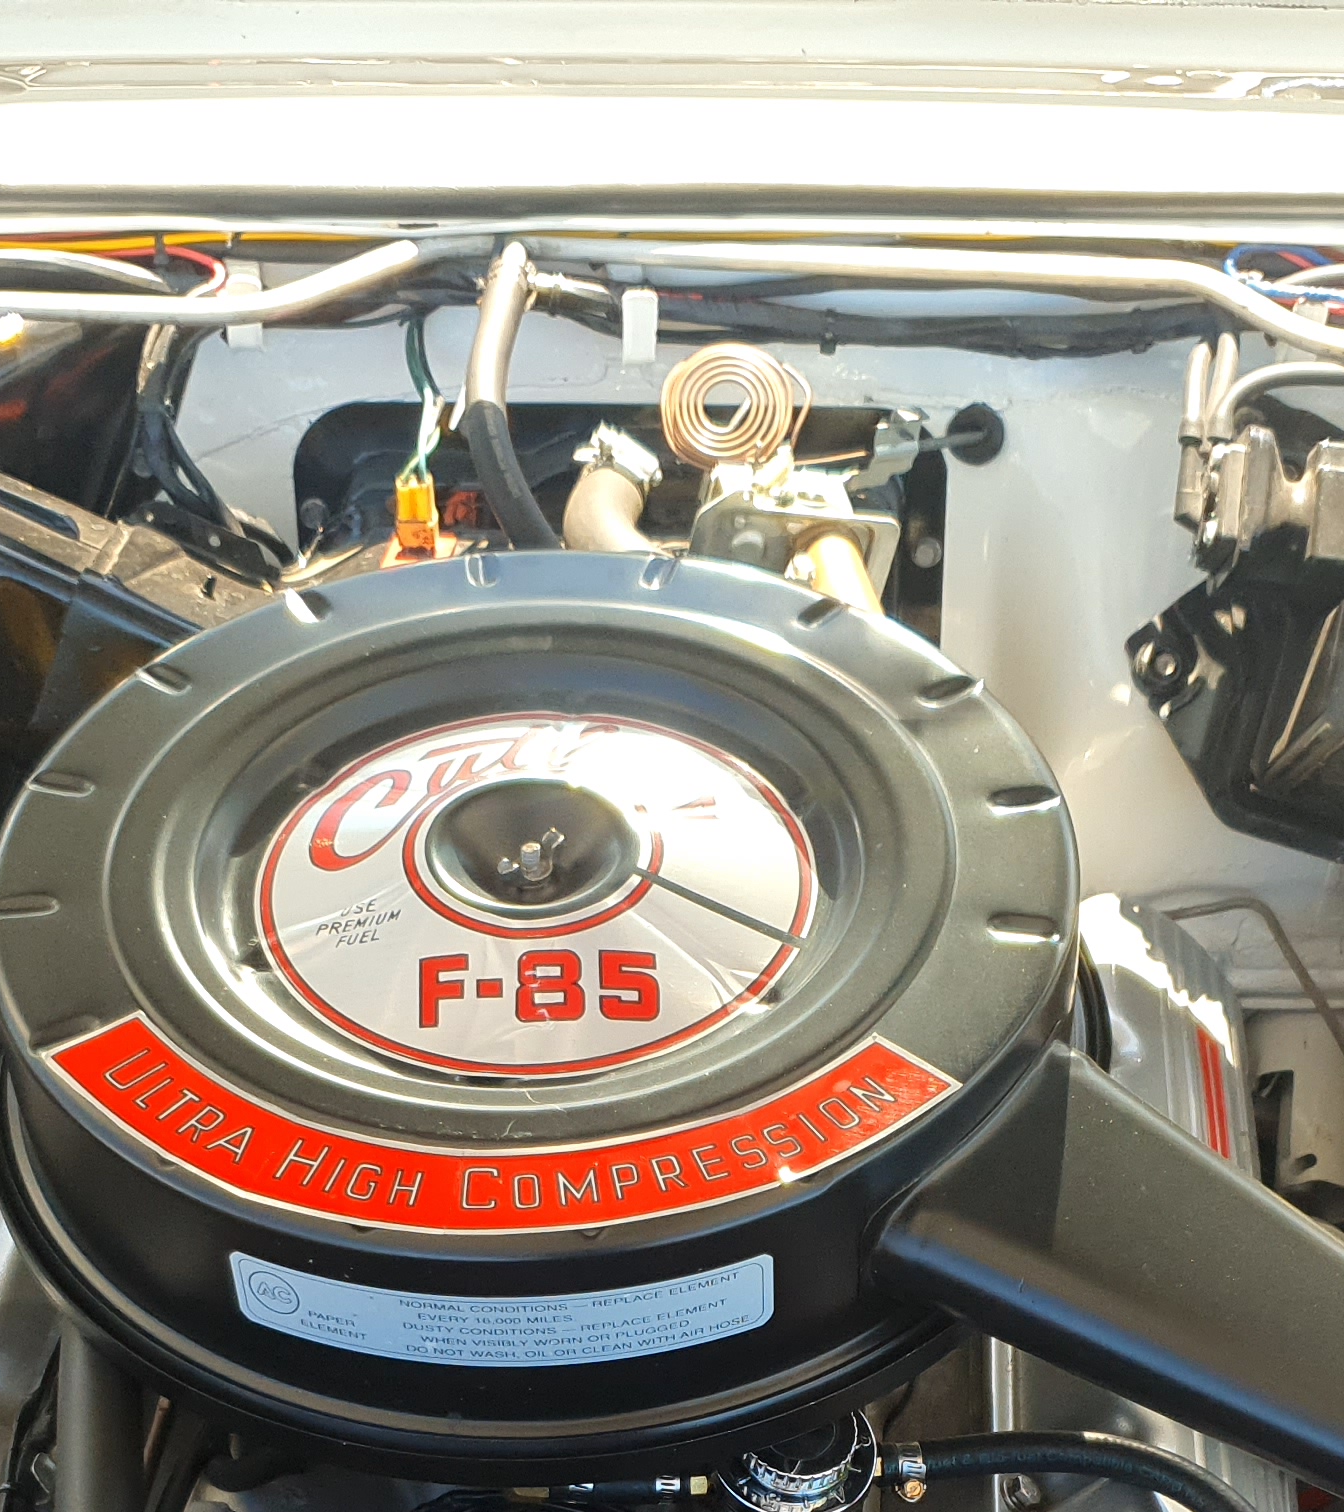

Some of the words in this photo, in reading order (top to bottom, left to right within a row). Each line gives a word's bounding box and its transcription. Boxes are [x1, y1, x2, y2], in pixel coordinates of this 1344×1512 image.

[341, 898, 377, 917] USE
[316, 909, 401, 936] PREMIUM
[335, 929, 380, 949] FUEL
[418, 949, 661, 1029] F-85
[103, 1048, 257, 1166] ULTRA
[273, 1138, 425, 1207] HIGH
[461, 1076, 898, 1210] COMPRESSION
[256, 1281, 293, 1305] AC
[399, 1300, 464, 1313] NORMAL
[470, 1303, 568, 1314] CONDITIONS
[592, 1291, 663, 1308] REPLACE
[669, 1271, 740, 1296] ELEMENT
[300, 1319, 368, 1340] ELEMENT
[308, 1310, 356, 1327] PAPER
[402, 1322, 454, 1334] DUSTY
[459, 1326, 557, 1336] CONDITIONS
[580, 1315, 651, 1332] REPLACE
[657, 1298, 728, 1321] ELEMENT
[417, 1312, 469, 1324] EVERY
[406, 1344, 429, 1354] DO
[433, 1347, 465, 1357] NOT
[524, 1349, 548, 1358] OIL
[554, 1348, 578, 1357] OR
[582, 1342, 633, 1355] CLEAN
[637, 1333, 676, 1347] WITH
[680, 1327, 705, 1340] AIR
[420, 1335, 467, 1347] WHEN
[472, 1339, 529, 1347] VISIBLY
[533, 1337, 583, 1347] WORN
[587, 1333, 611, 1343] OR
[615, 1319, 690, 1339] PLUGGED
